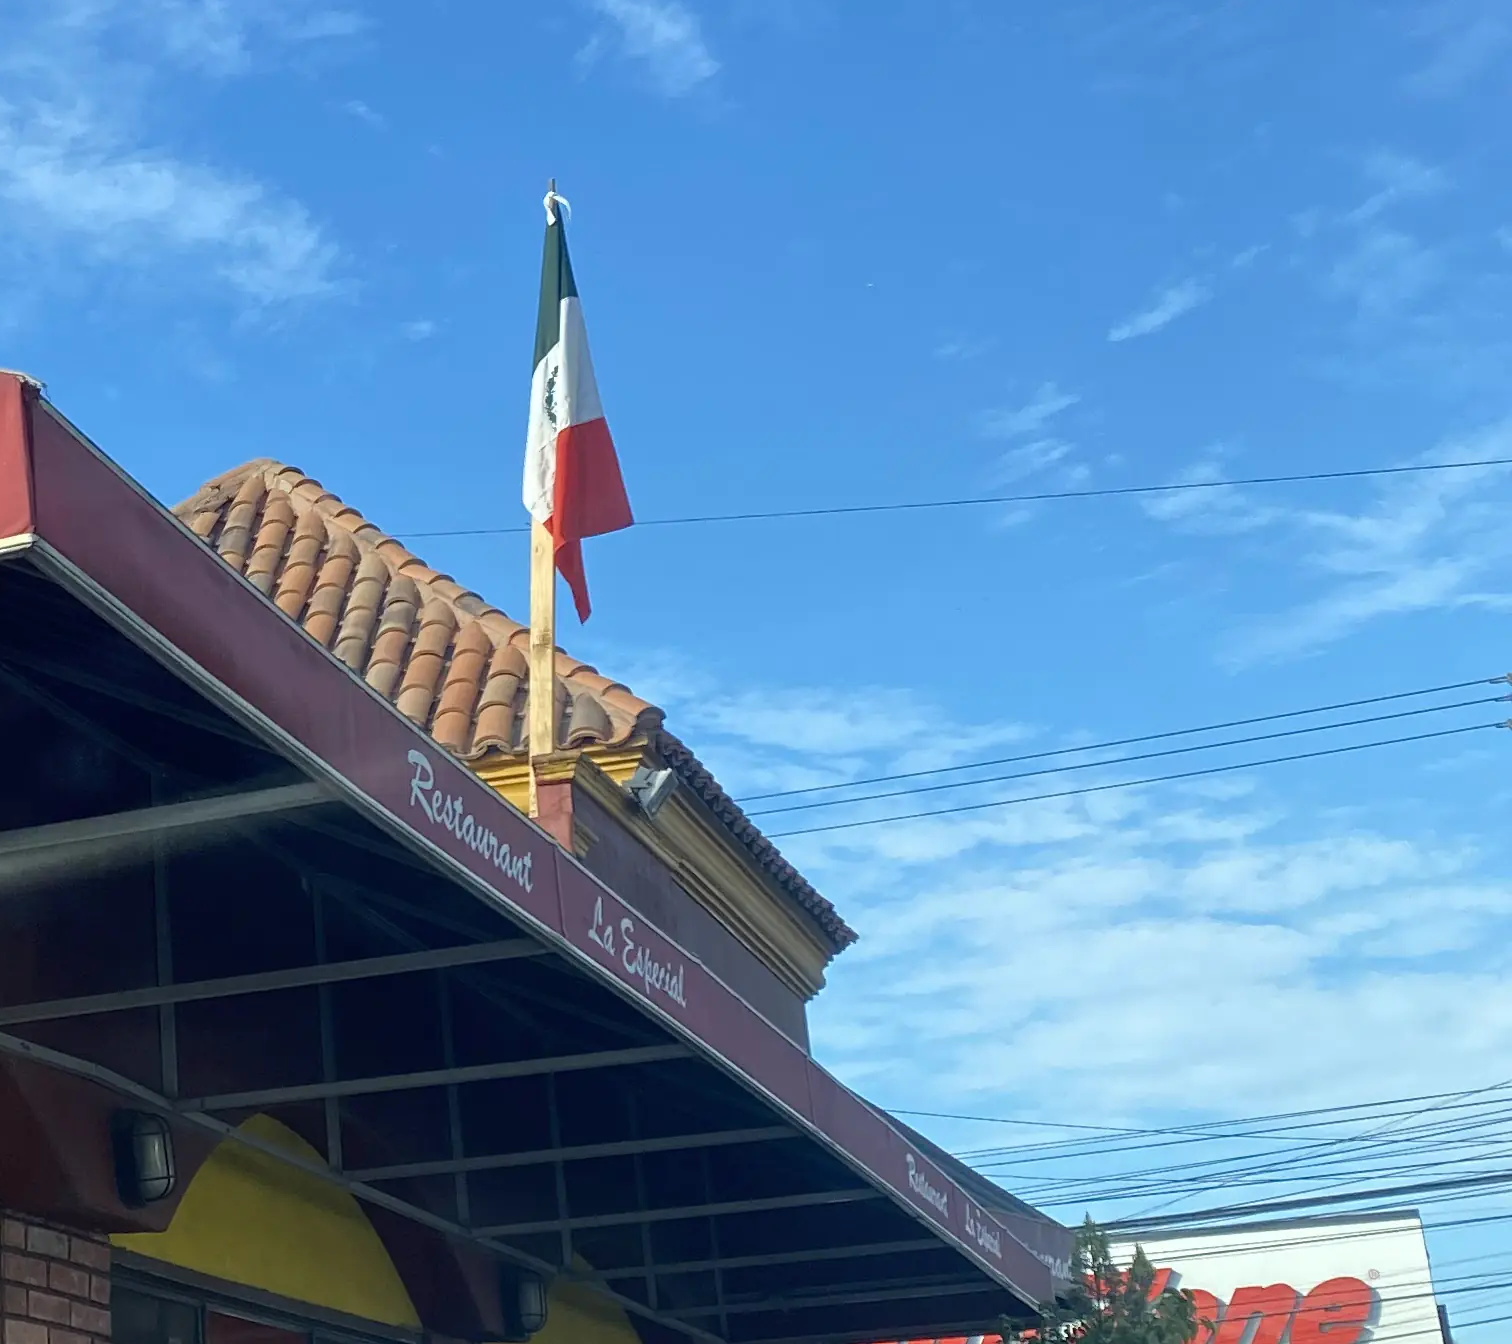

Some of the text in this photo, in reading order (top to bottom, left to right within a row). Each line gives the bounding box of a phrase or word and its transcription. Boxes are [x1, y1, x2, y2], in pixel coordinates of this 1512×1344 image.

[407, 749, 534, 893] Restaurant
[589, 896, 688, 1008] La Especial
